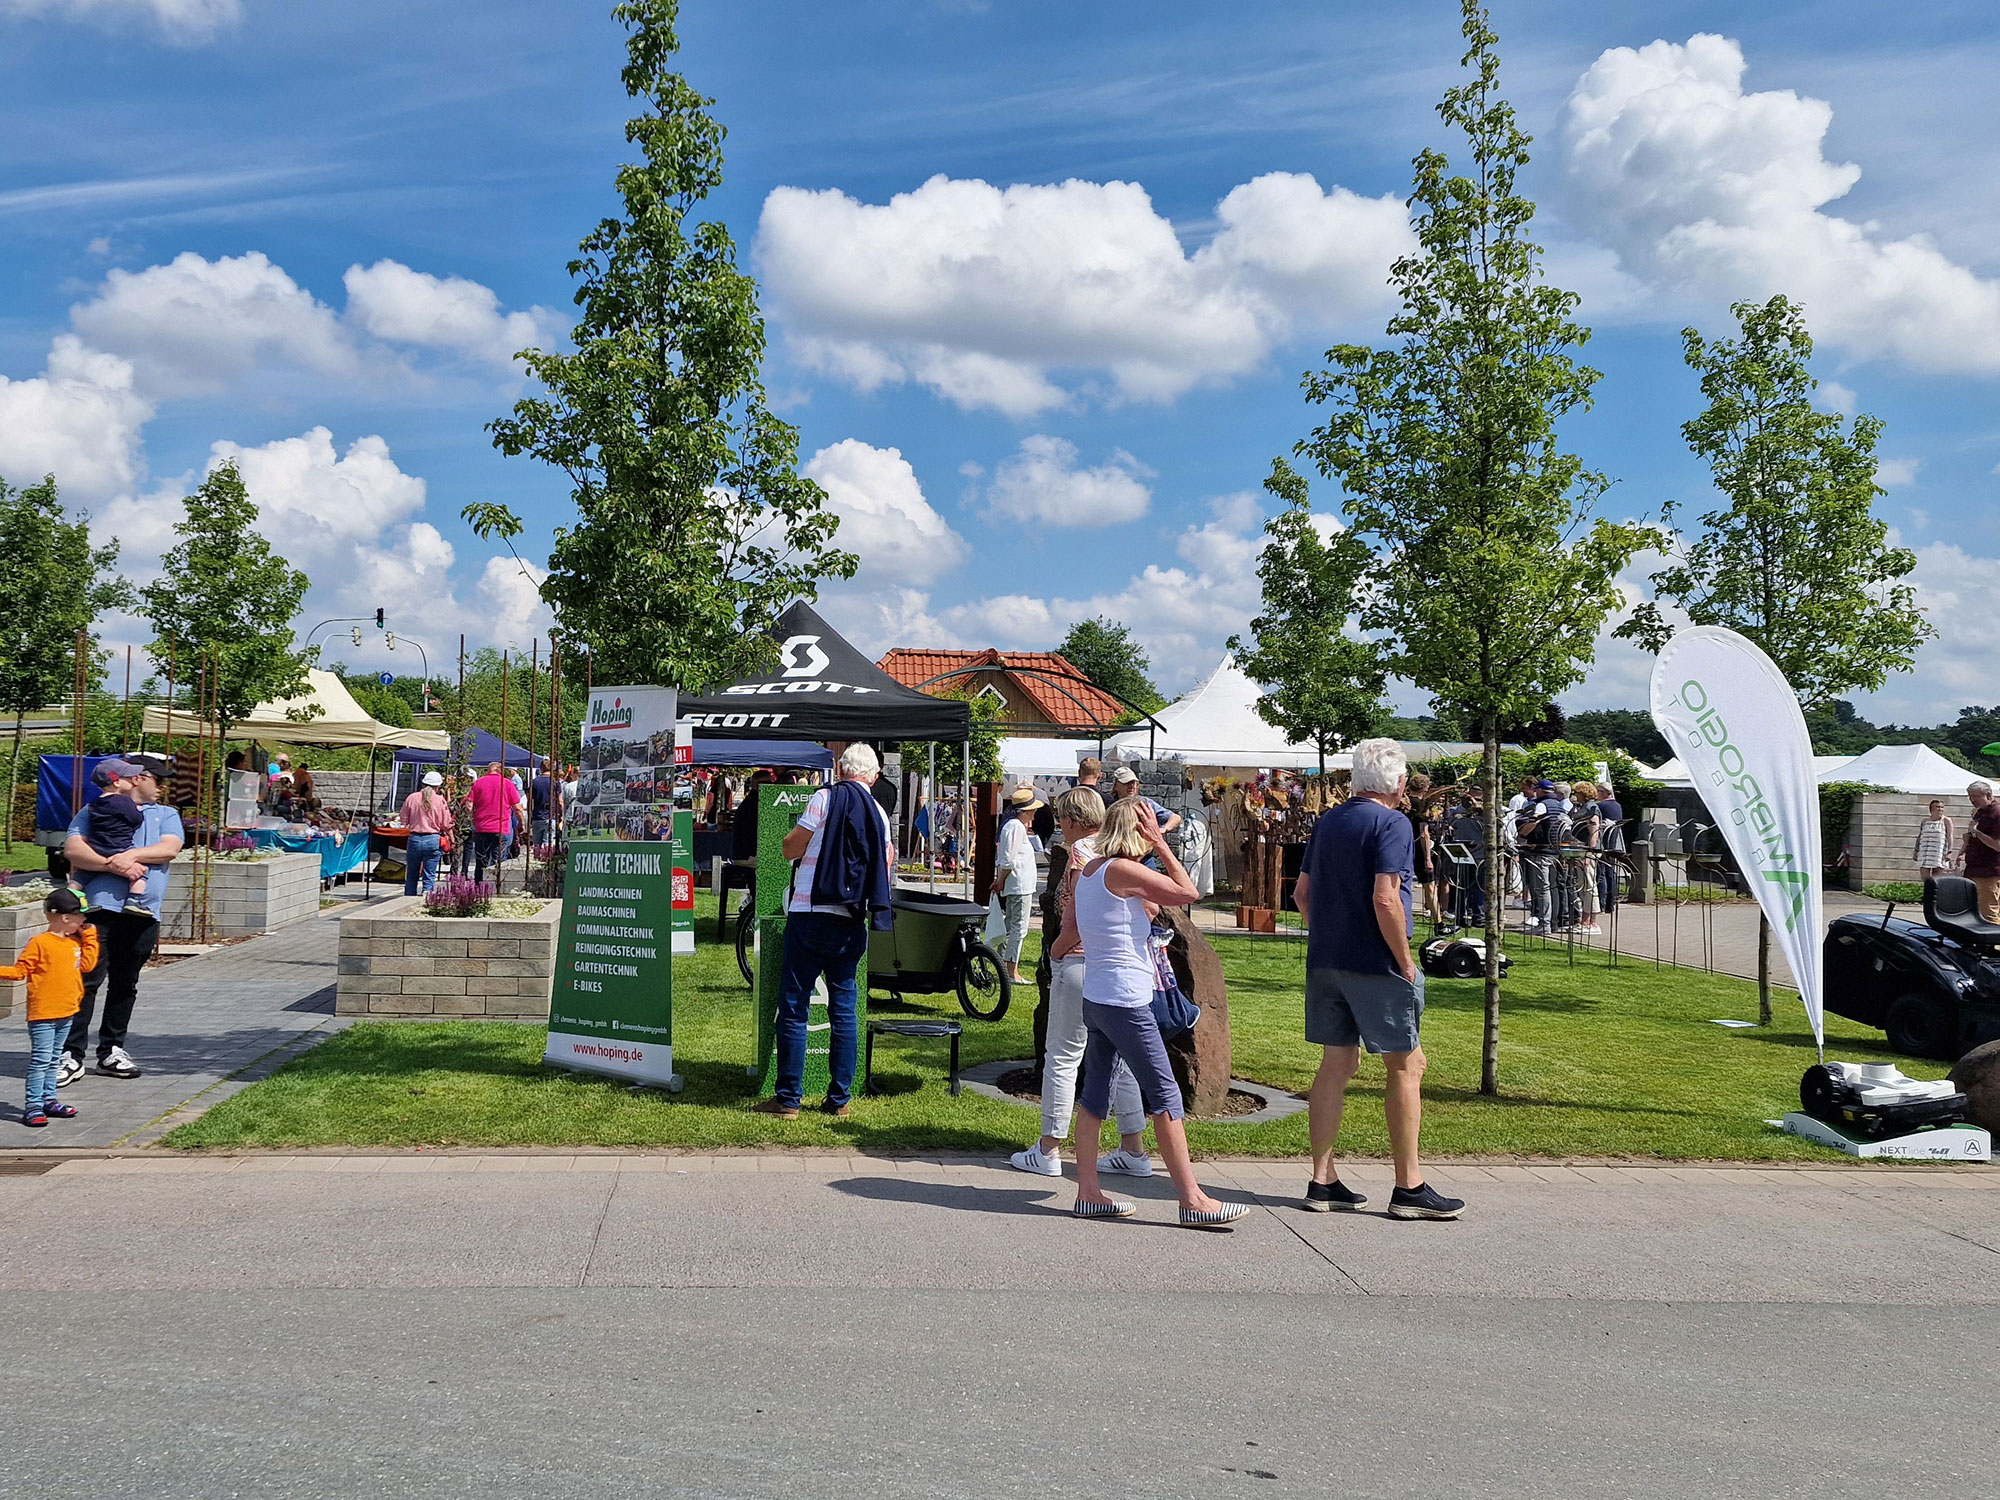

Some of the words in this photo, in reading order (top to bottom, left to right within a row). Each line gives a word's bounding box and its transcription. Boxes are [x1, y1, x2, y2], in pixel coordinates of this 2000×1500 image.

[720, 680, 881, 696] SCOTT
[591, 697, 632, 727] Hoping
[682, 713, 790, 728] SCOTT
[574, 852, 611, 874] STARKE
[614, 853, 661, 875] TECHNIK
[578, 886, 642, 900] LANDMASCHINEN
[577, 905, 636, 919] BAUMASCHINEN
[576, 924, 654, 939] KOMMUNALTECHNIK
[575, 942, 657, 959] REINIGUNGSTECHNIK
[574, 961, 638, 977] GARTENTECHNIK
[573, 979, 602, 993] E-BIKES
[573, 1043, 643, 1063] www.hoping.de
